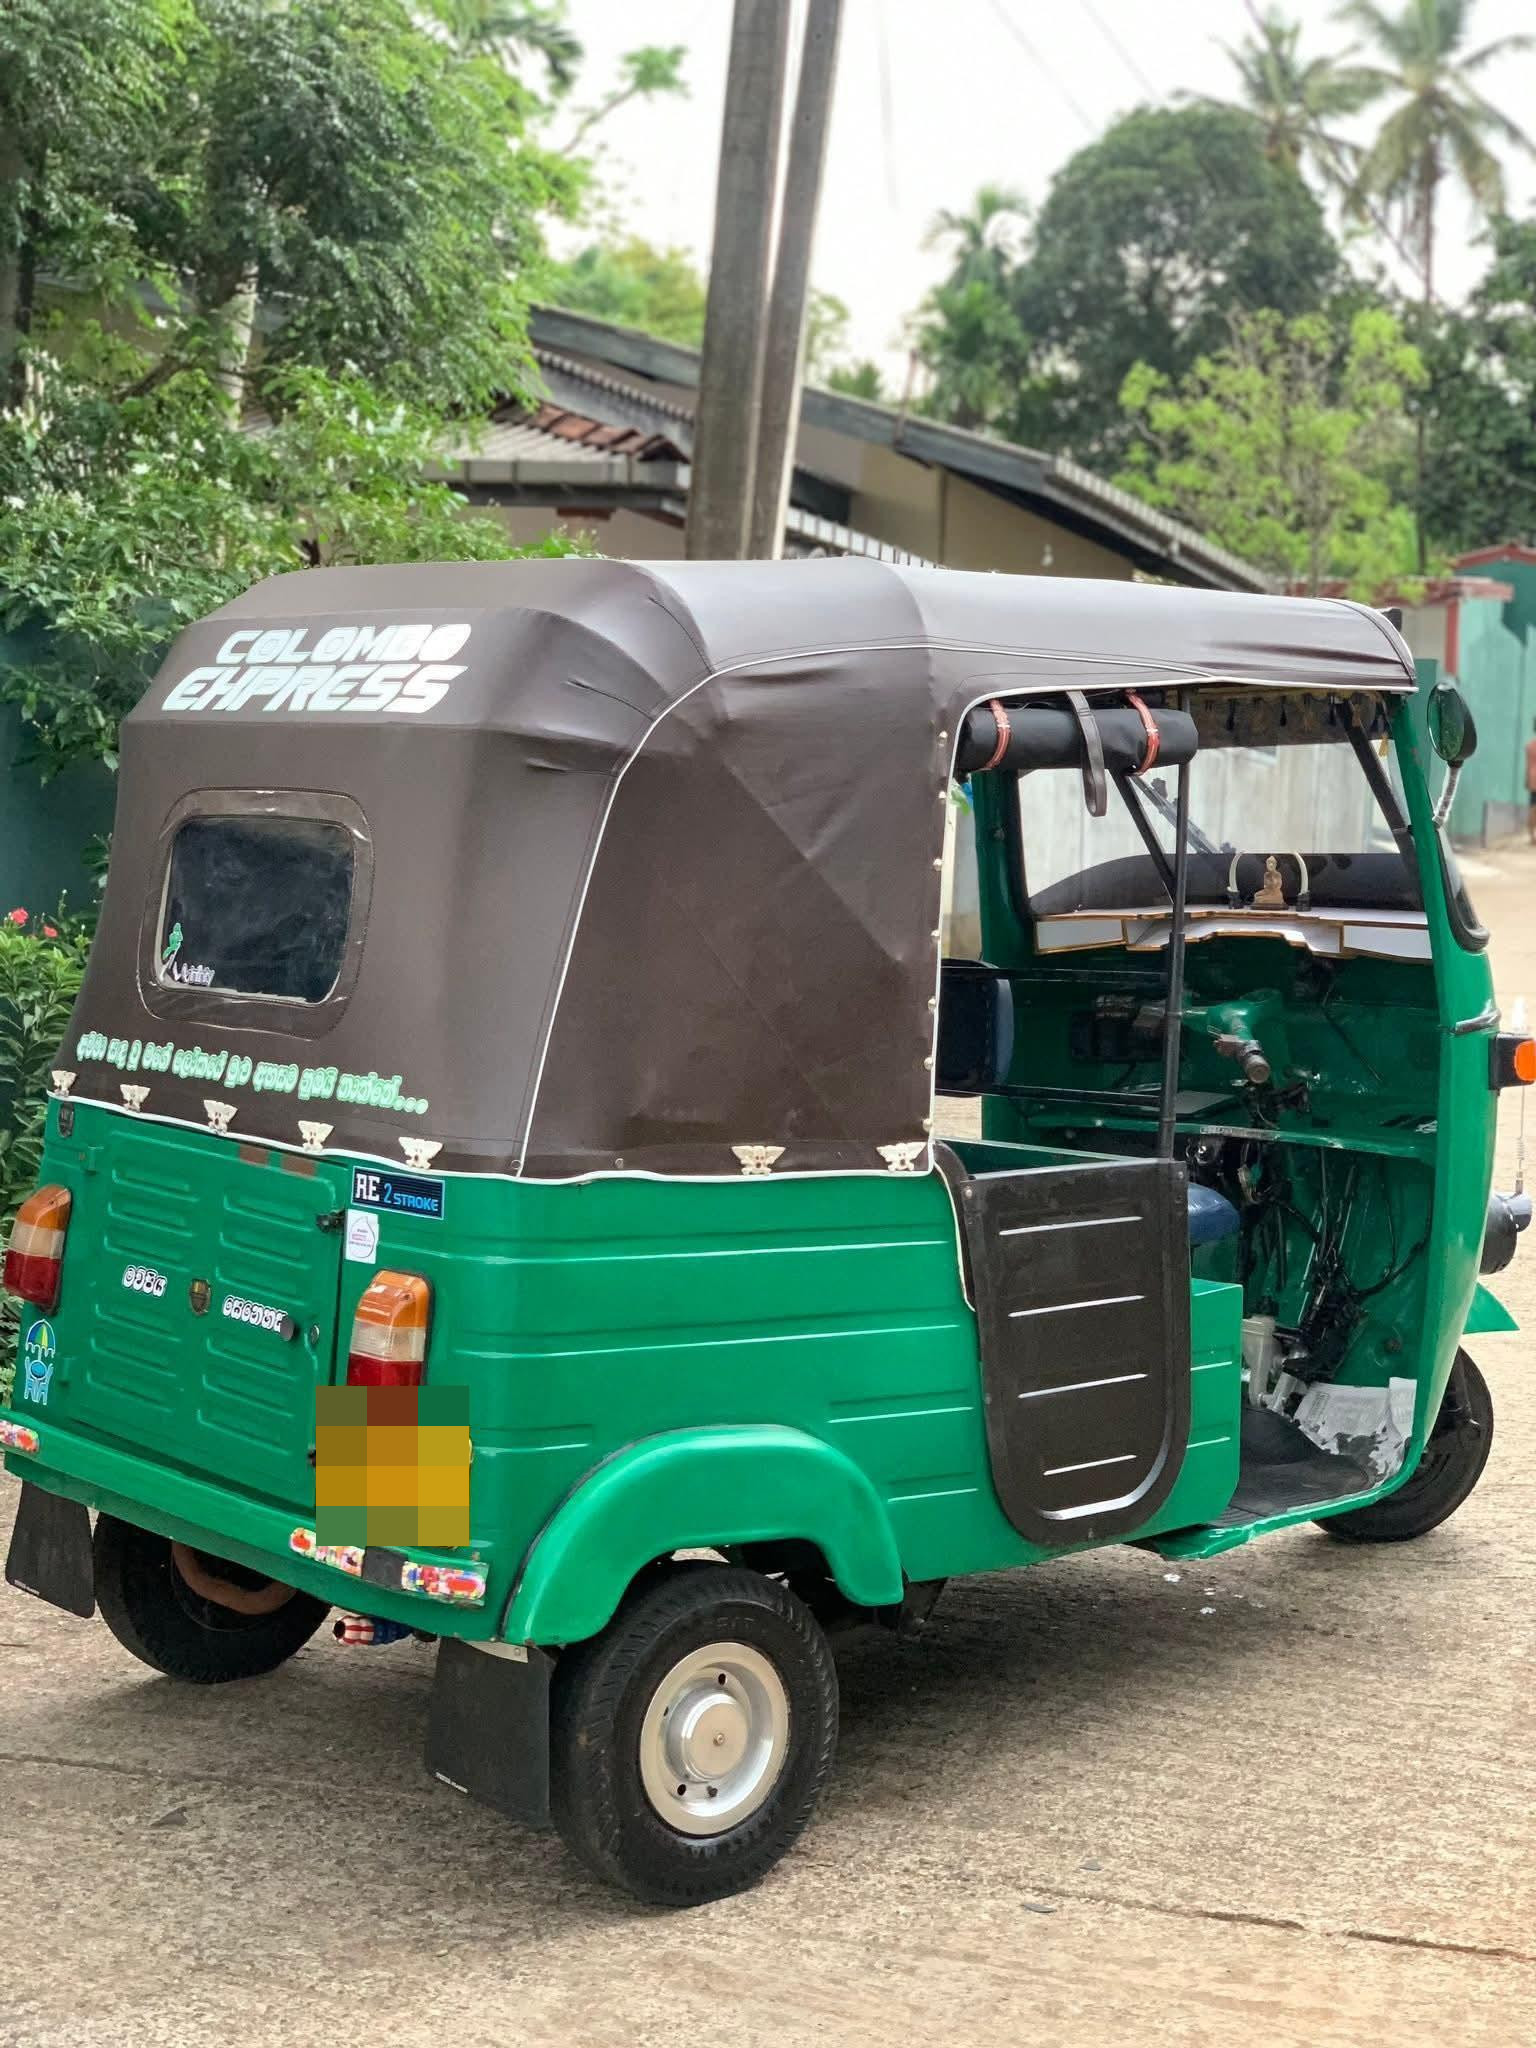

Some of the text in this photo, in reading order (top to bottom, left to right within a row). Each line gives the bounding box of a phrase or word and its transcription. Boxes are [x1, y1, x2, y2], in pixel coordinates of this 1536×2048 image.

[216, 624, 472, 664] COLOMBO
[355, 1173, 439, 1211] RE 2 STROKE
